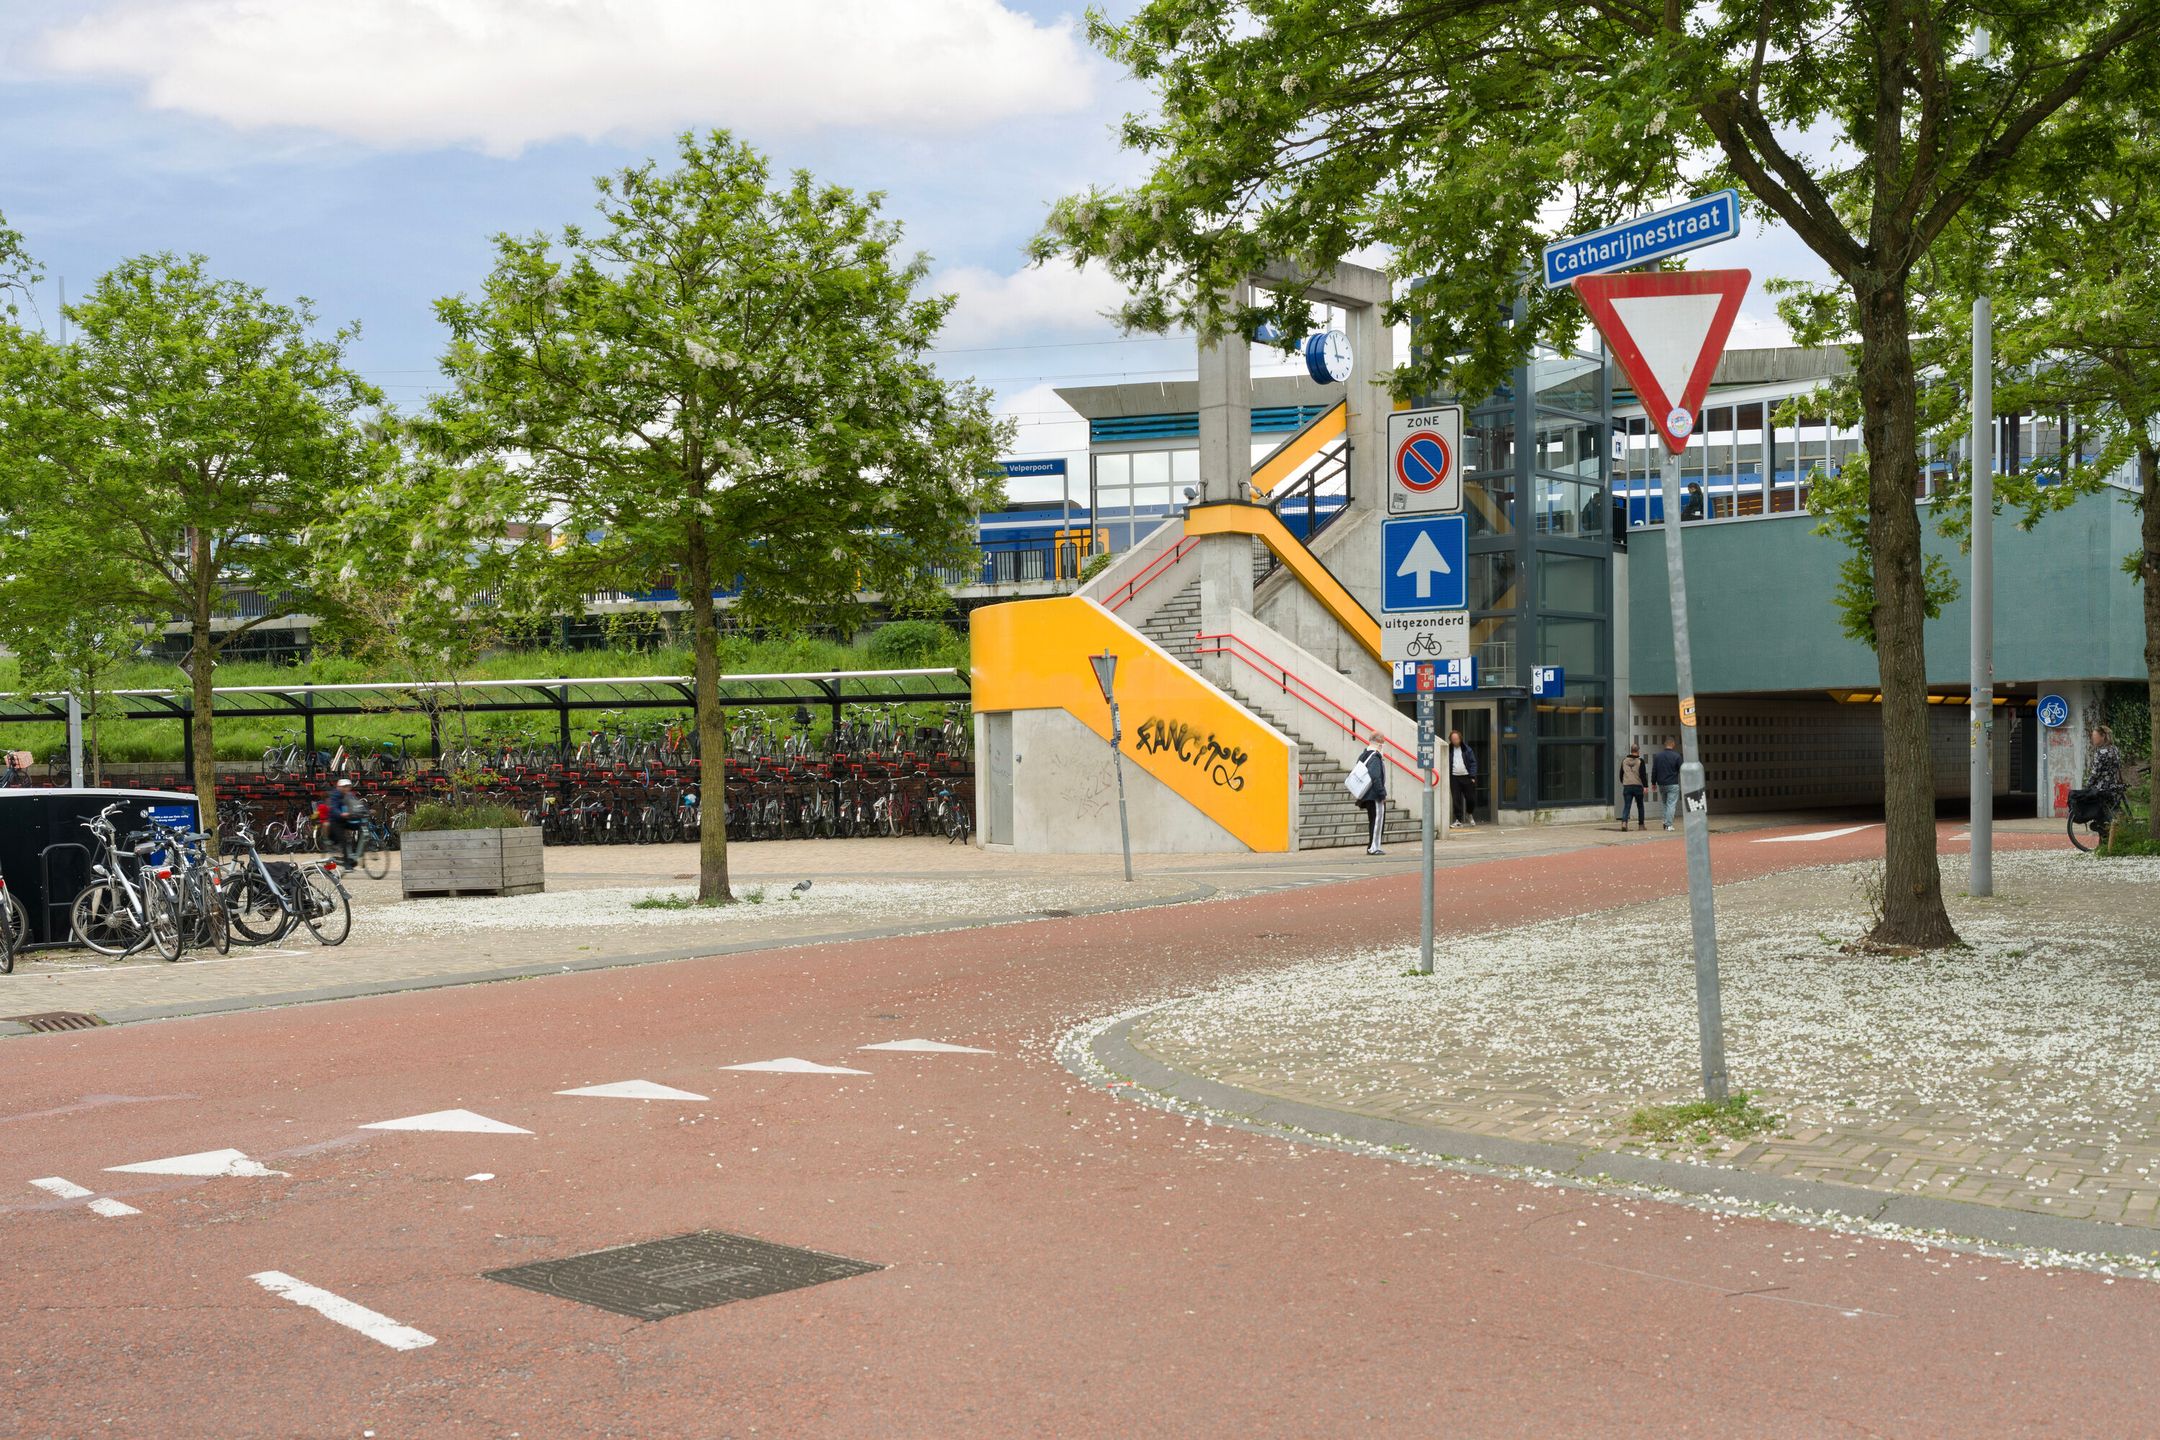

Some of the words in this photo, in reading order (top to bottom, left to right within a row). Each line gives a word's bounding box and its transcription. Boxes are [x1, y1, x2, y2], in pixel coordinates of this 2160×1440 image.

[1554, 204, 1721, 274] Catharijnestraat
[1407, 415, 1440, 428] ZONE
[1009, 463, 1054, 472] Velperpoort
[1384, 615, 1464, 631] uitgezonderd
